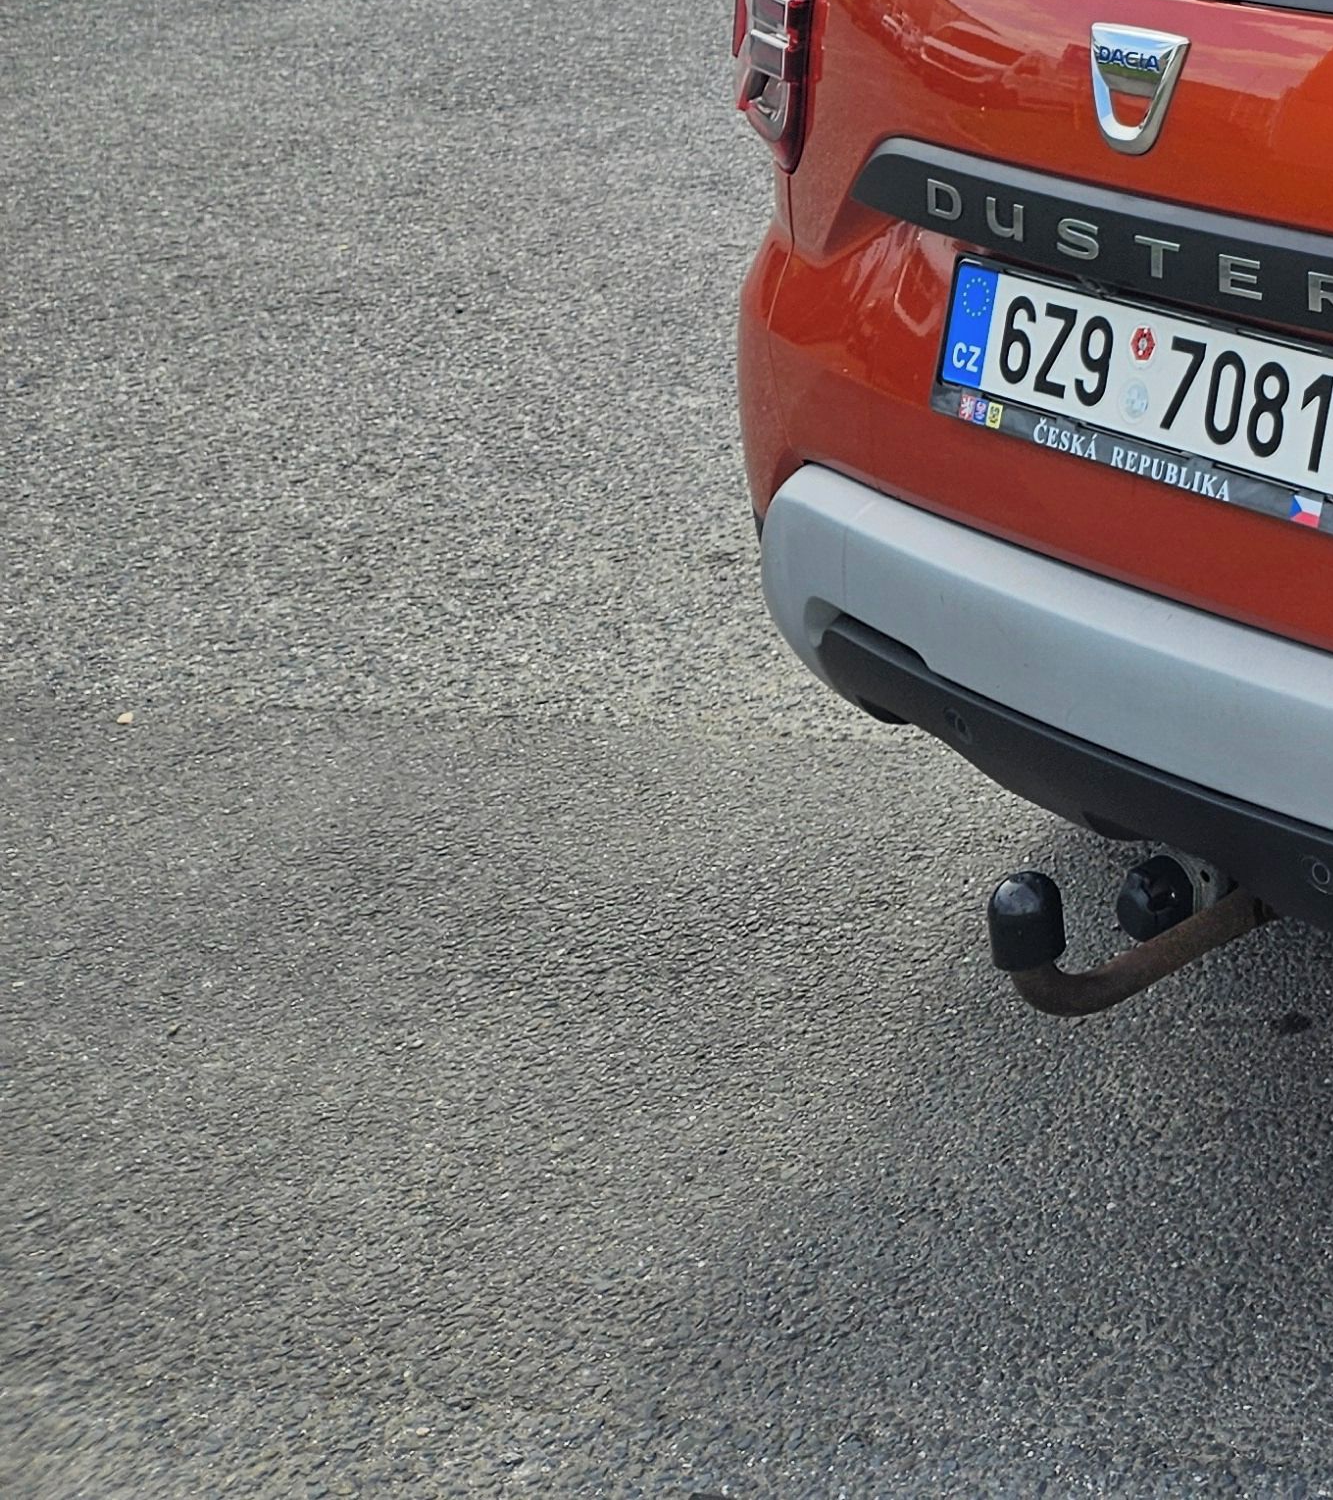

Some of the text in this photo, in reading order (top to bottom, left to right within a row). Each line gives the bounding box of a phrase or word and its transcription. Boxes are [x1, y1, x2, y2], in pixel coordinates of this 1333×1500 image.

[1098, 45, 1161, 72] DACIA
[952, 341, 982, 373] CZ
[998, 295, 1114, 407] 6Z9
[1032, 417, 1231, 502] ČESKÁ REPUBLIKA
